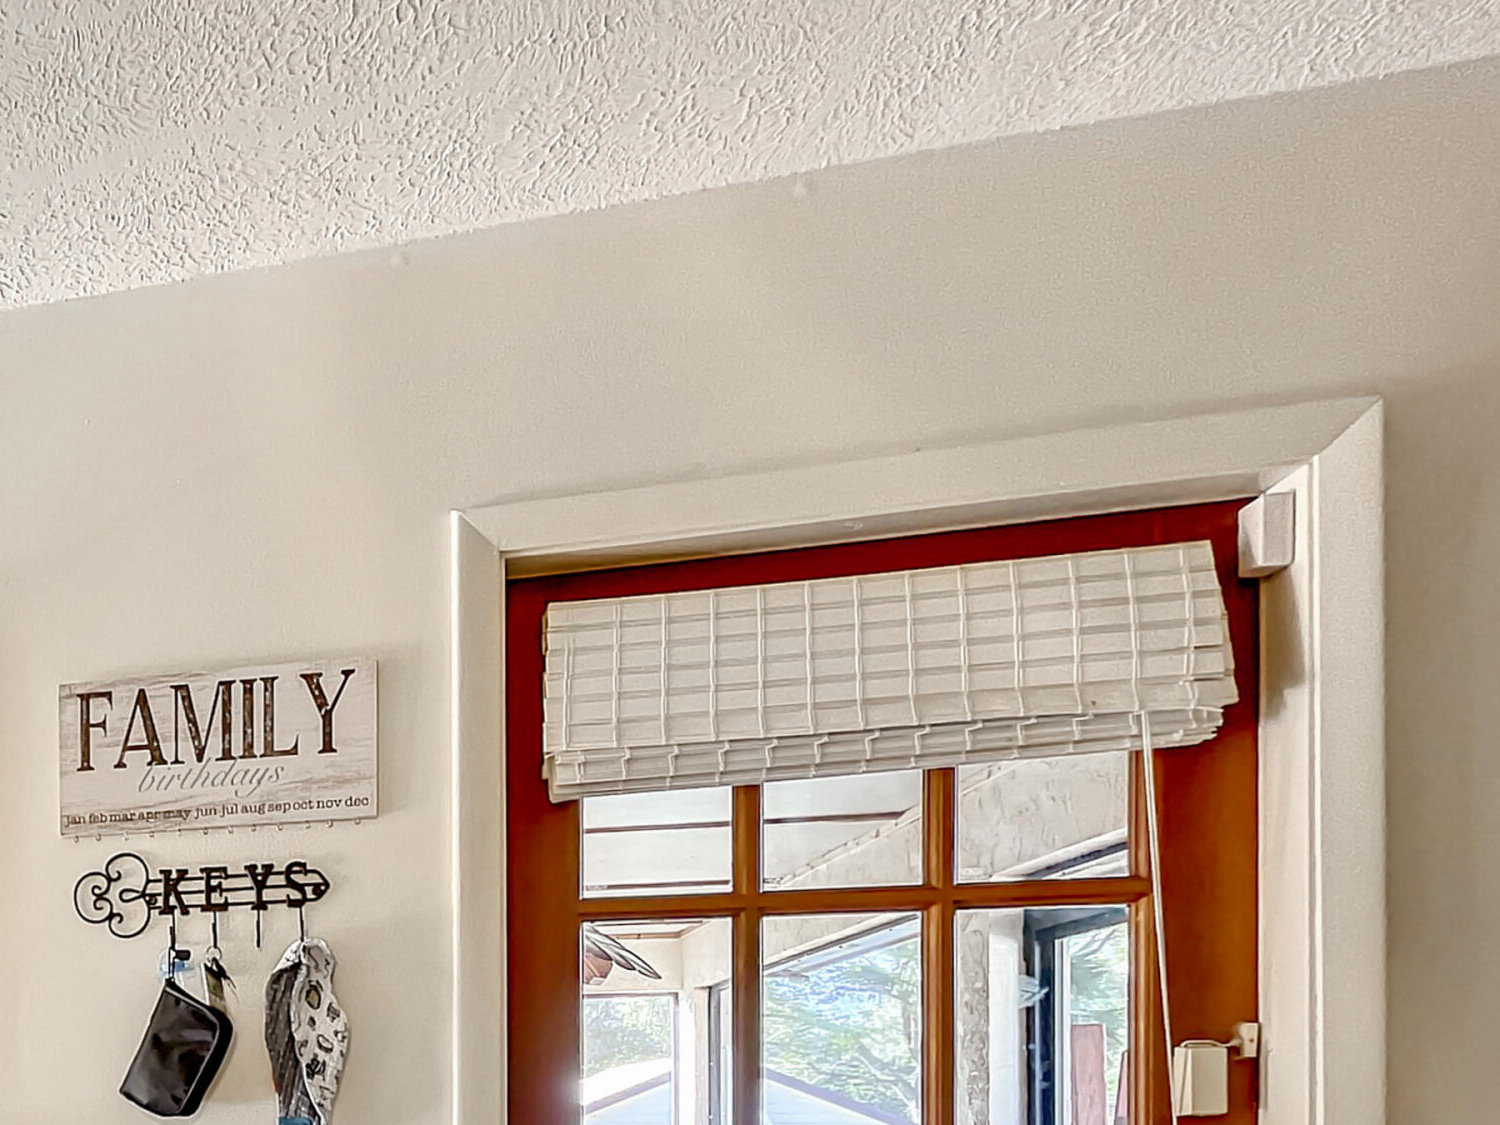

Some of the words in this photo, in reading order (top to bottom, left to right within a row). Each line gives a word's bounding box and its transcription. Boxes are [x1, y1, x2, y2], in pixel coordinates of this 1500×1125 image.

[76, 668, 356, 772] FAMILY
[138, 756, 285, 798] birthdays
[88, 812, 108, 825] feb
[109, 811, 137, 823] mar
[138, 810, 161, 823] apr
[161, 808, 192, 821] may
[194, 807, 218, 820] jun
[220, 803, 239, 818] jul
[241, 803, 266, 815] aug
[268, 802, 292, 814] sep
[293, 799, 315, 811] oct
[316, 798, 342, 810] nov
[344, 795, 370, 808] dec
[158, 860, 309, 917] KEYS
